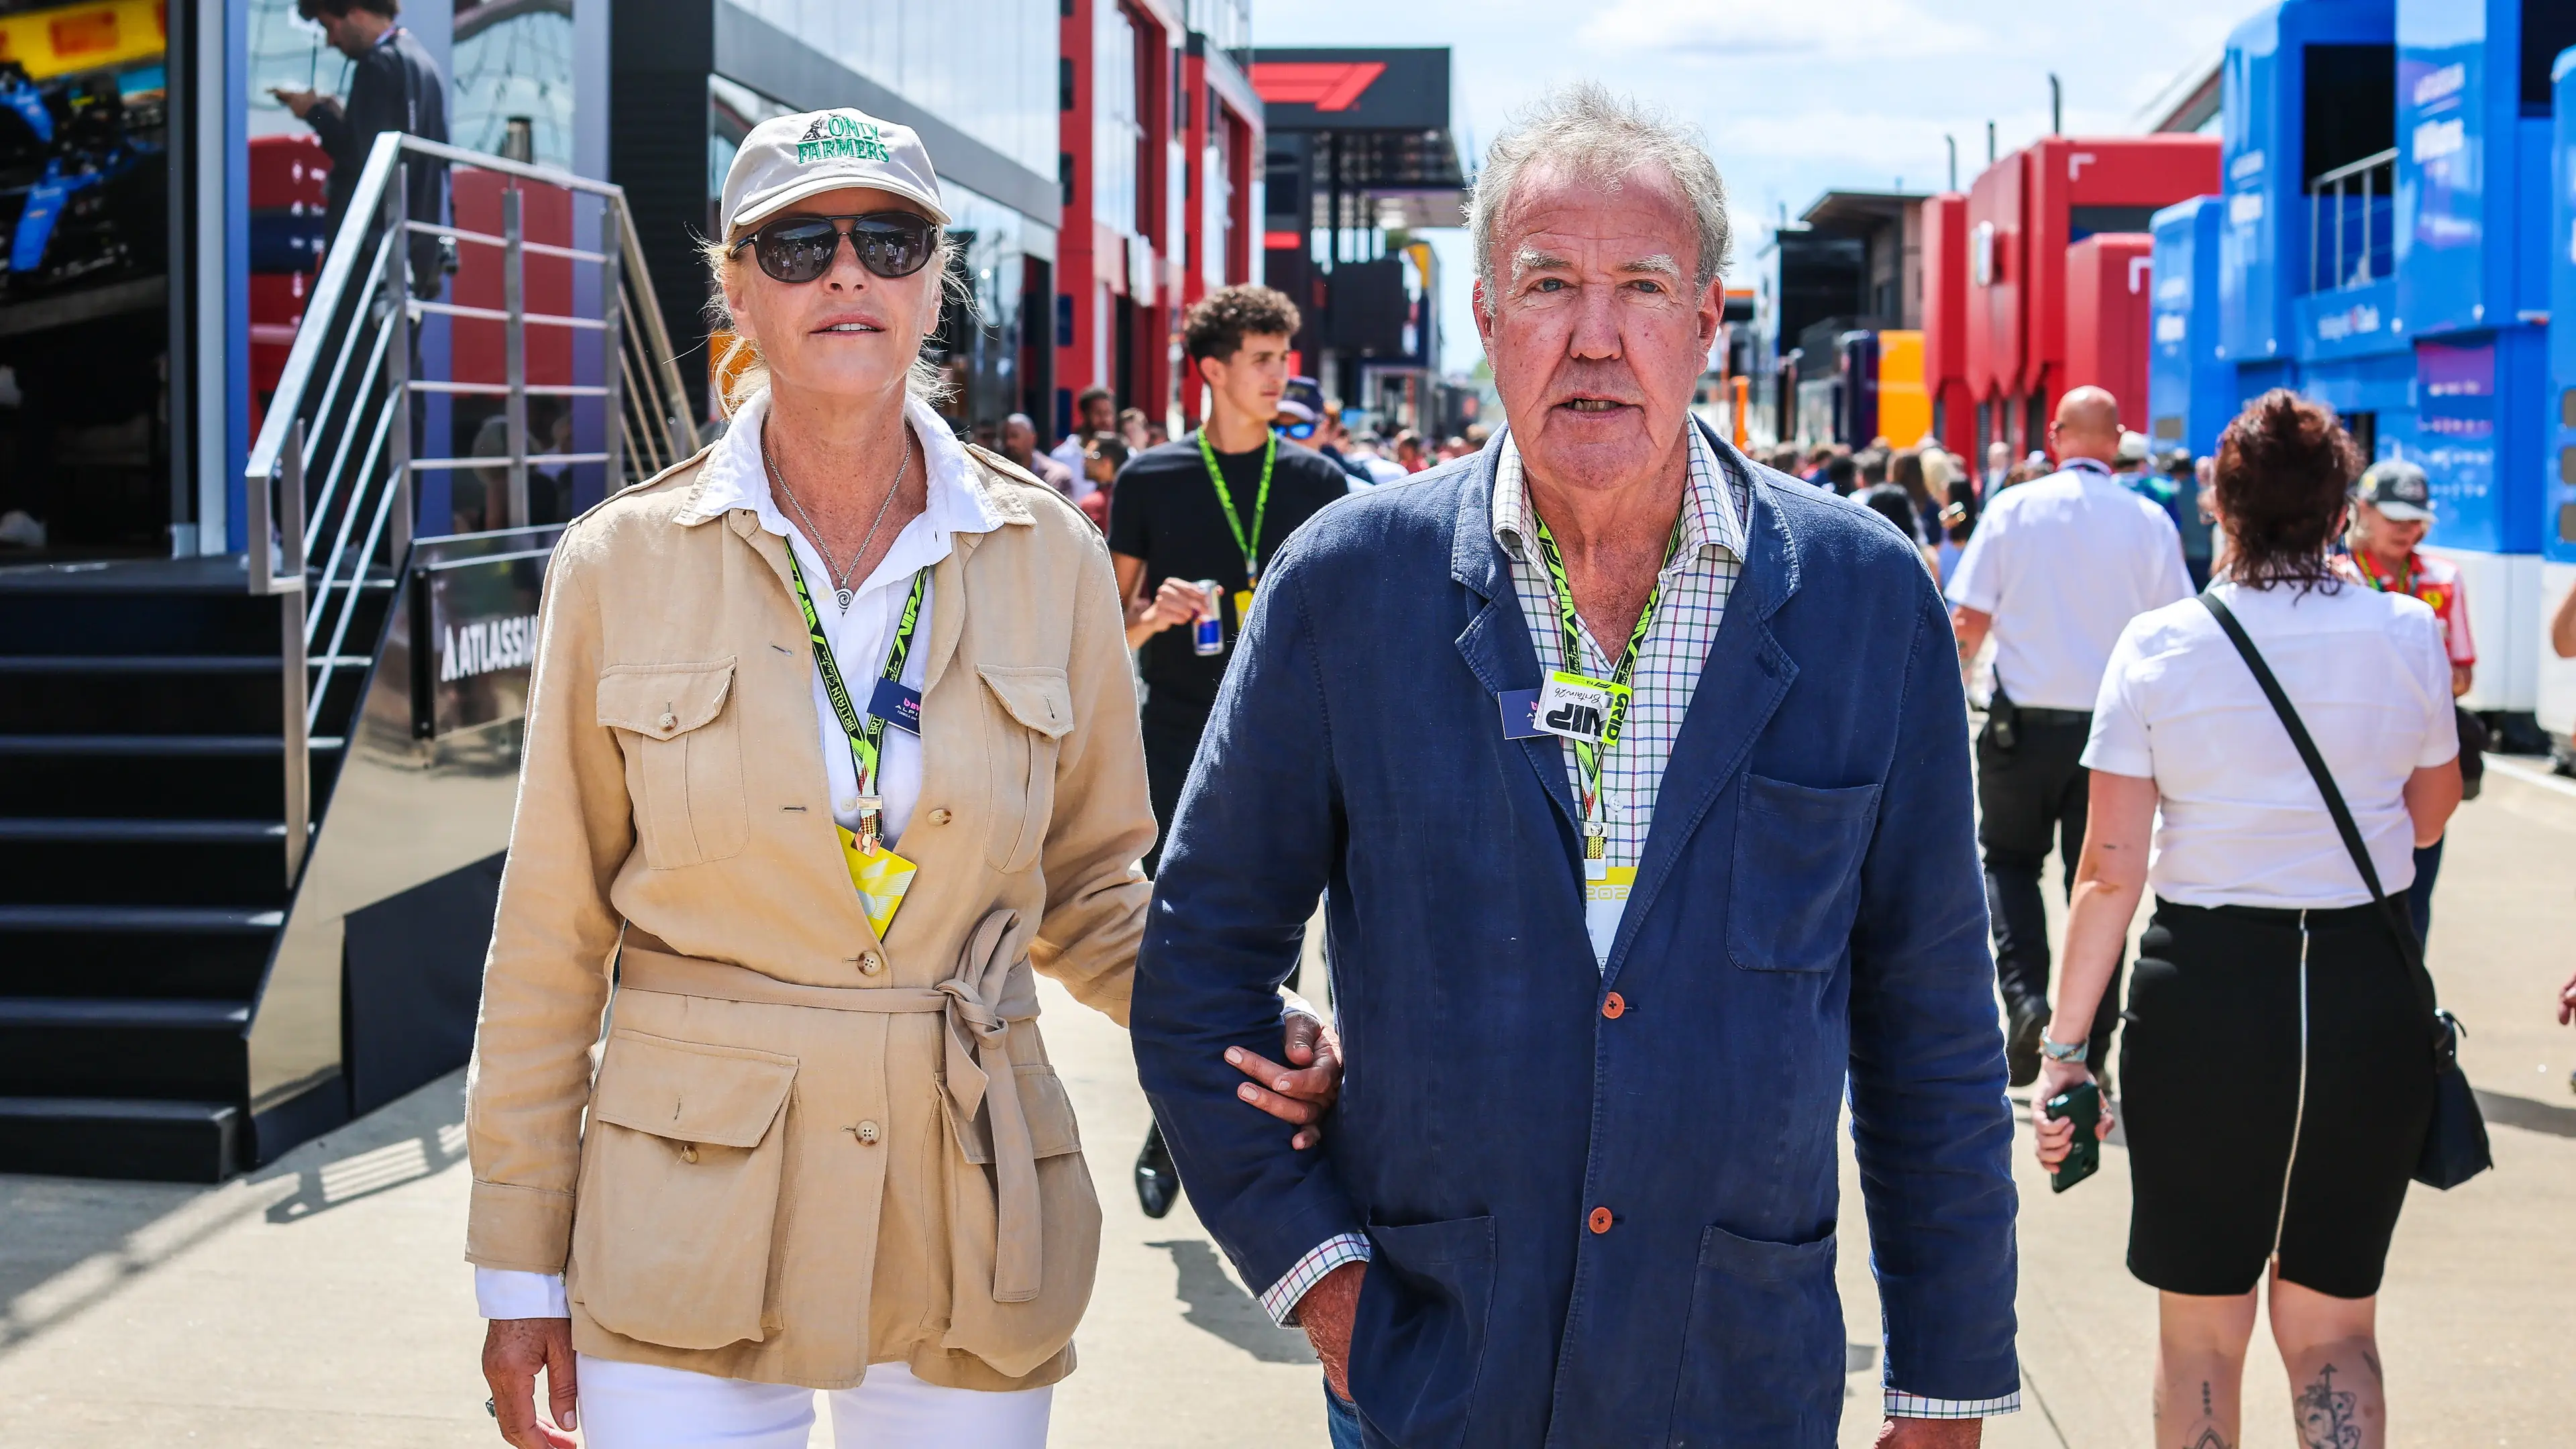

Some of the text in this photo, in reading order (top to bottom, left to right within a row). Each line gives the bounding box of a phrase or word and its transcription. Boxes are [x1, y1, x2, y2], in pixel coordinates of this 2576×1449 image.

[828, 116, 880, 141] ONLY
[796, 138, 890, 164] FARMERS
[898, 596, 918, 636] VIP
[1555, 578, 1575, 620] VIP
[1631, 603, 1652, 641] VIP
[820, 651, 839, 686] Silverstone
[831, 686, 855, 732] BRITAIN
[895, 704, 918, 716] ALPI
[1546, 702, 1602, 738] VIP
[1607, 693, 1629, 741] GRID
[1587, 887, 1629, 900] 202
